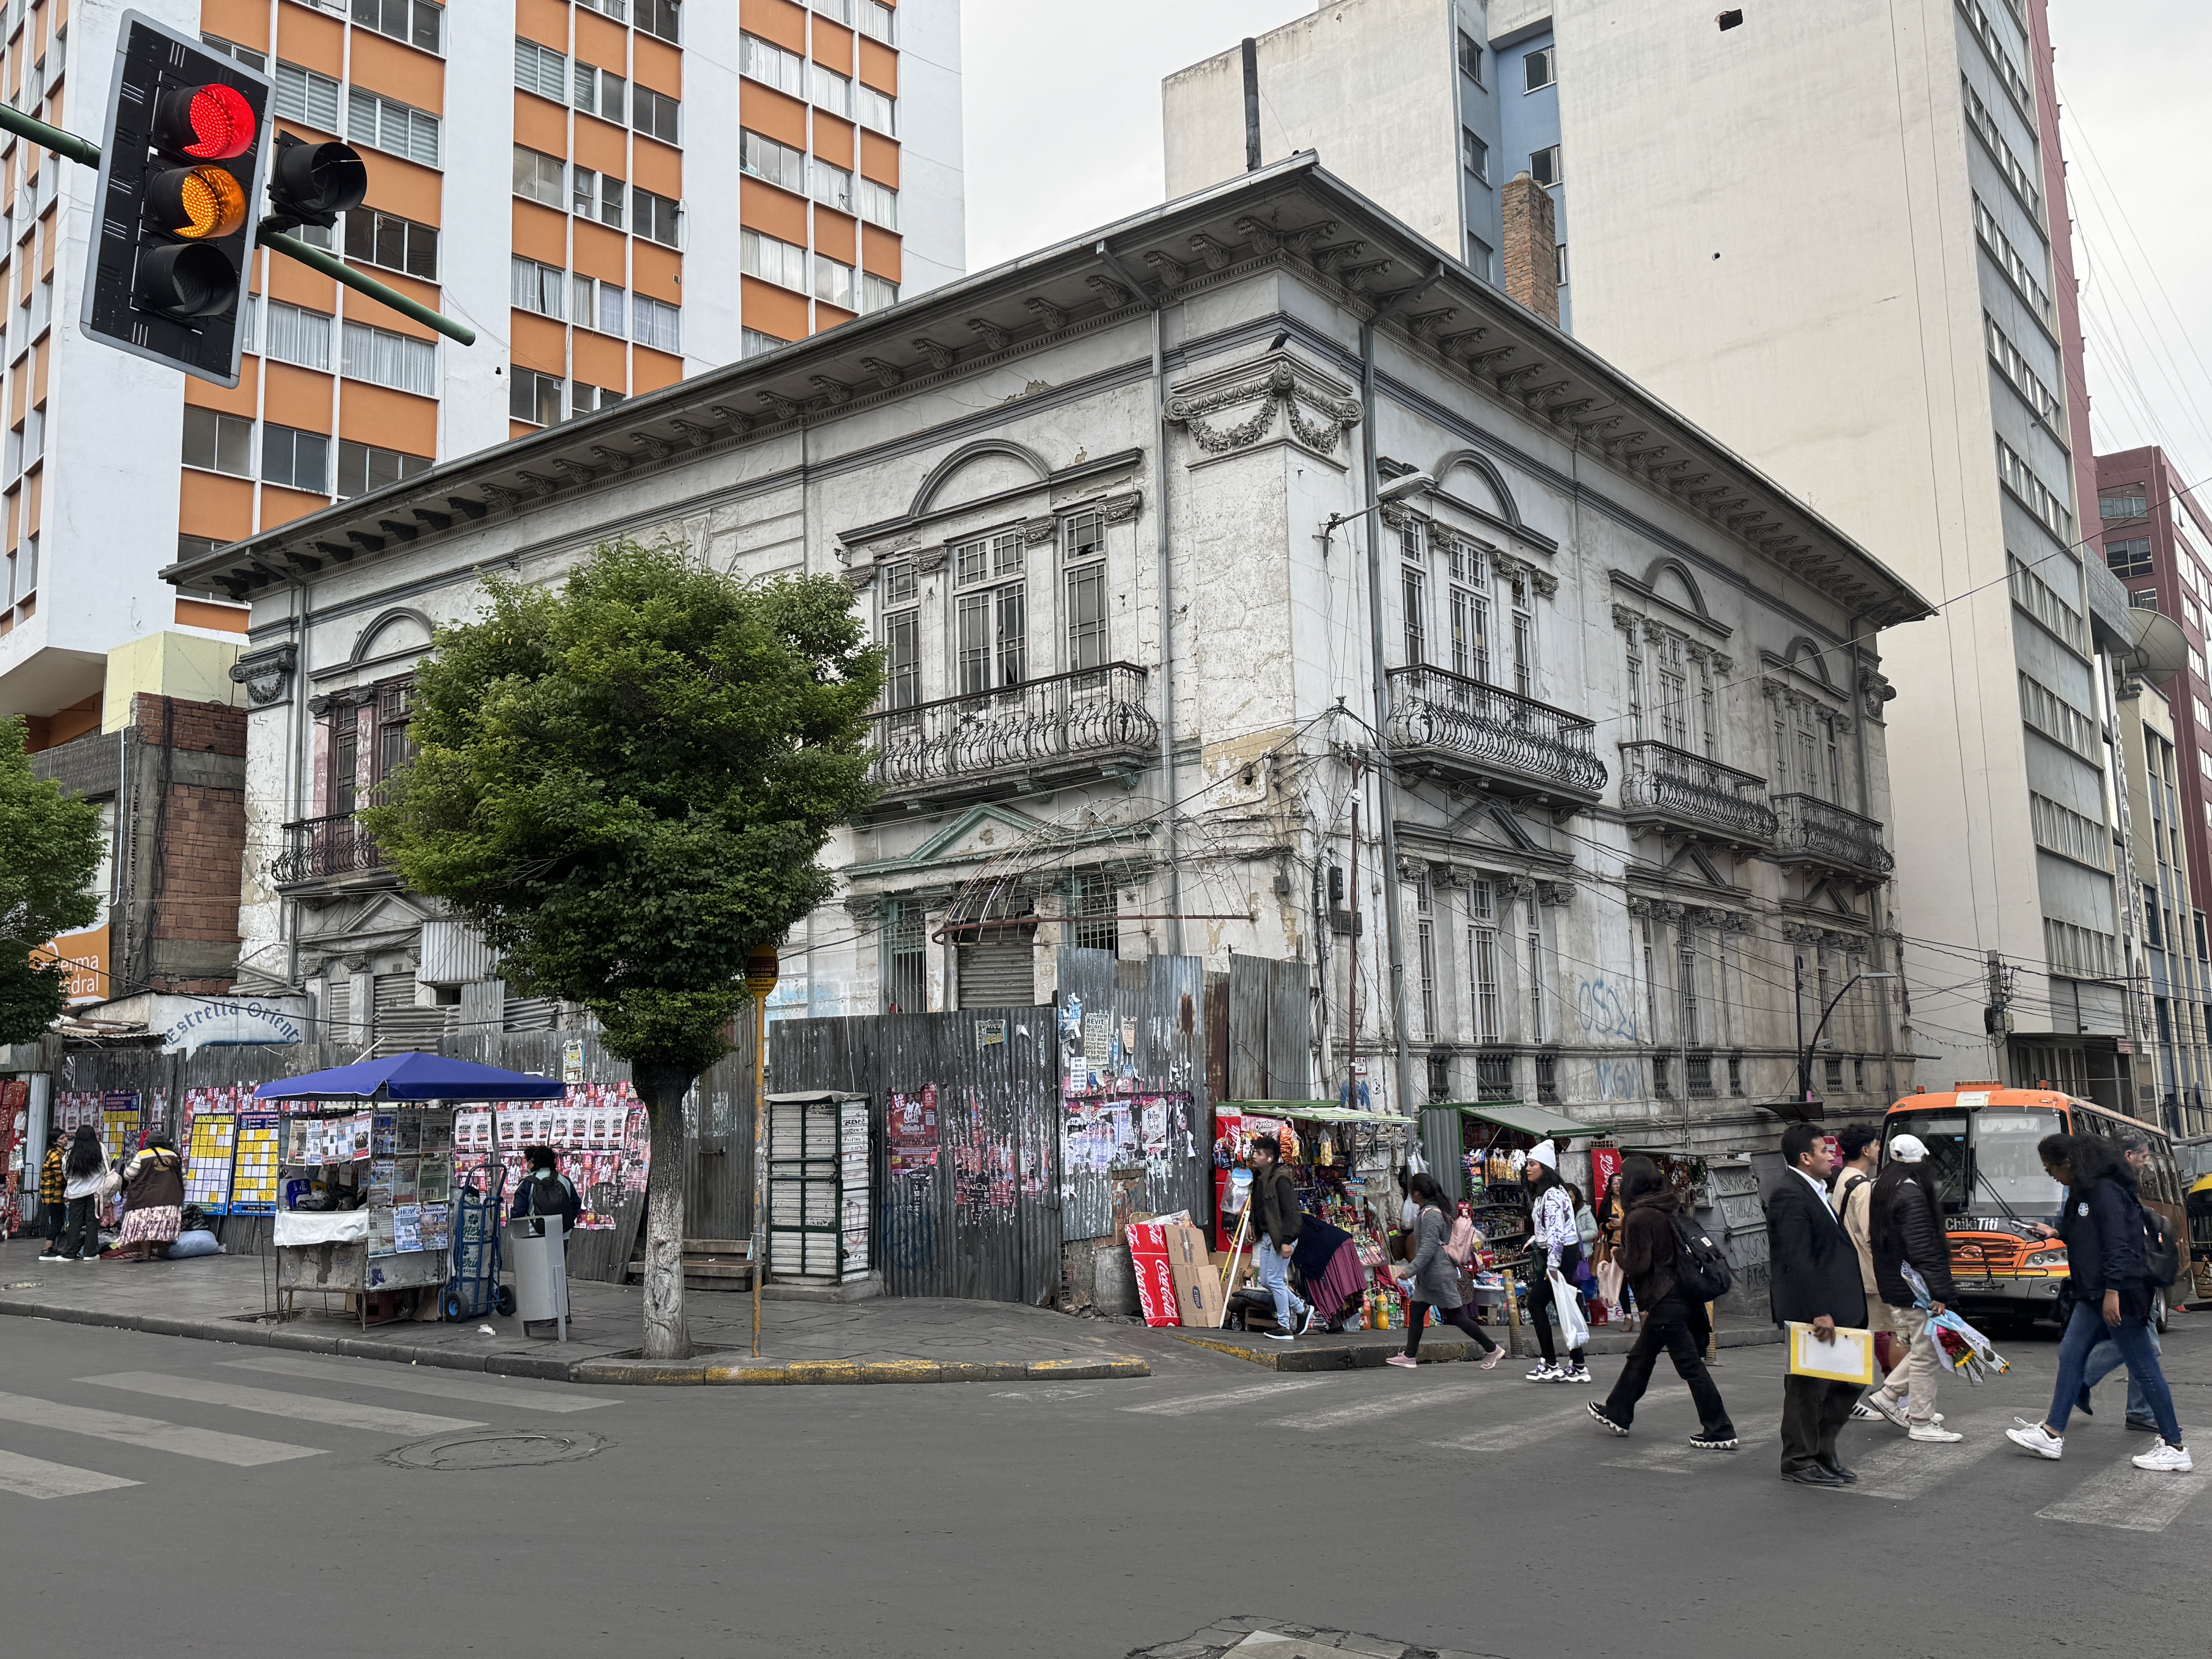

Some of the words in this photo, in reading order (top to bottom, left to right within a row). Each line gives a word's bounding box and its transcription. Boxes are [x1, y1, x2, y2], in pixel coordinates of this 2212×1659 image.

[60, 955, 98, 971] erma
[165, 1000, 239, 1046] Estrella
[893, 1093, 903, 1101] LO
[895, 1100, 905, 1108] VE
[195, 1115, 213, 1123] ANUNCIOS
[213, 1115, 235, 1123] LABORALES
[1155, 1259, 1178, 1317] Coca-Cola
